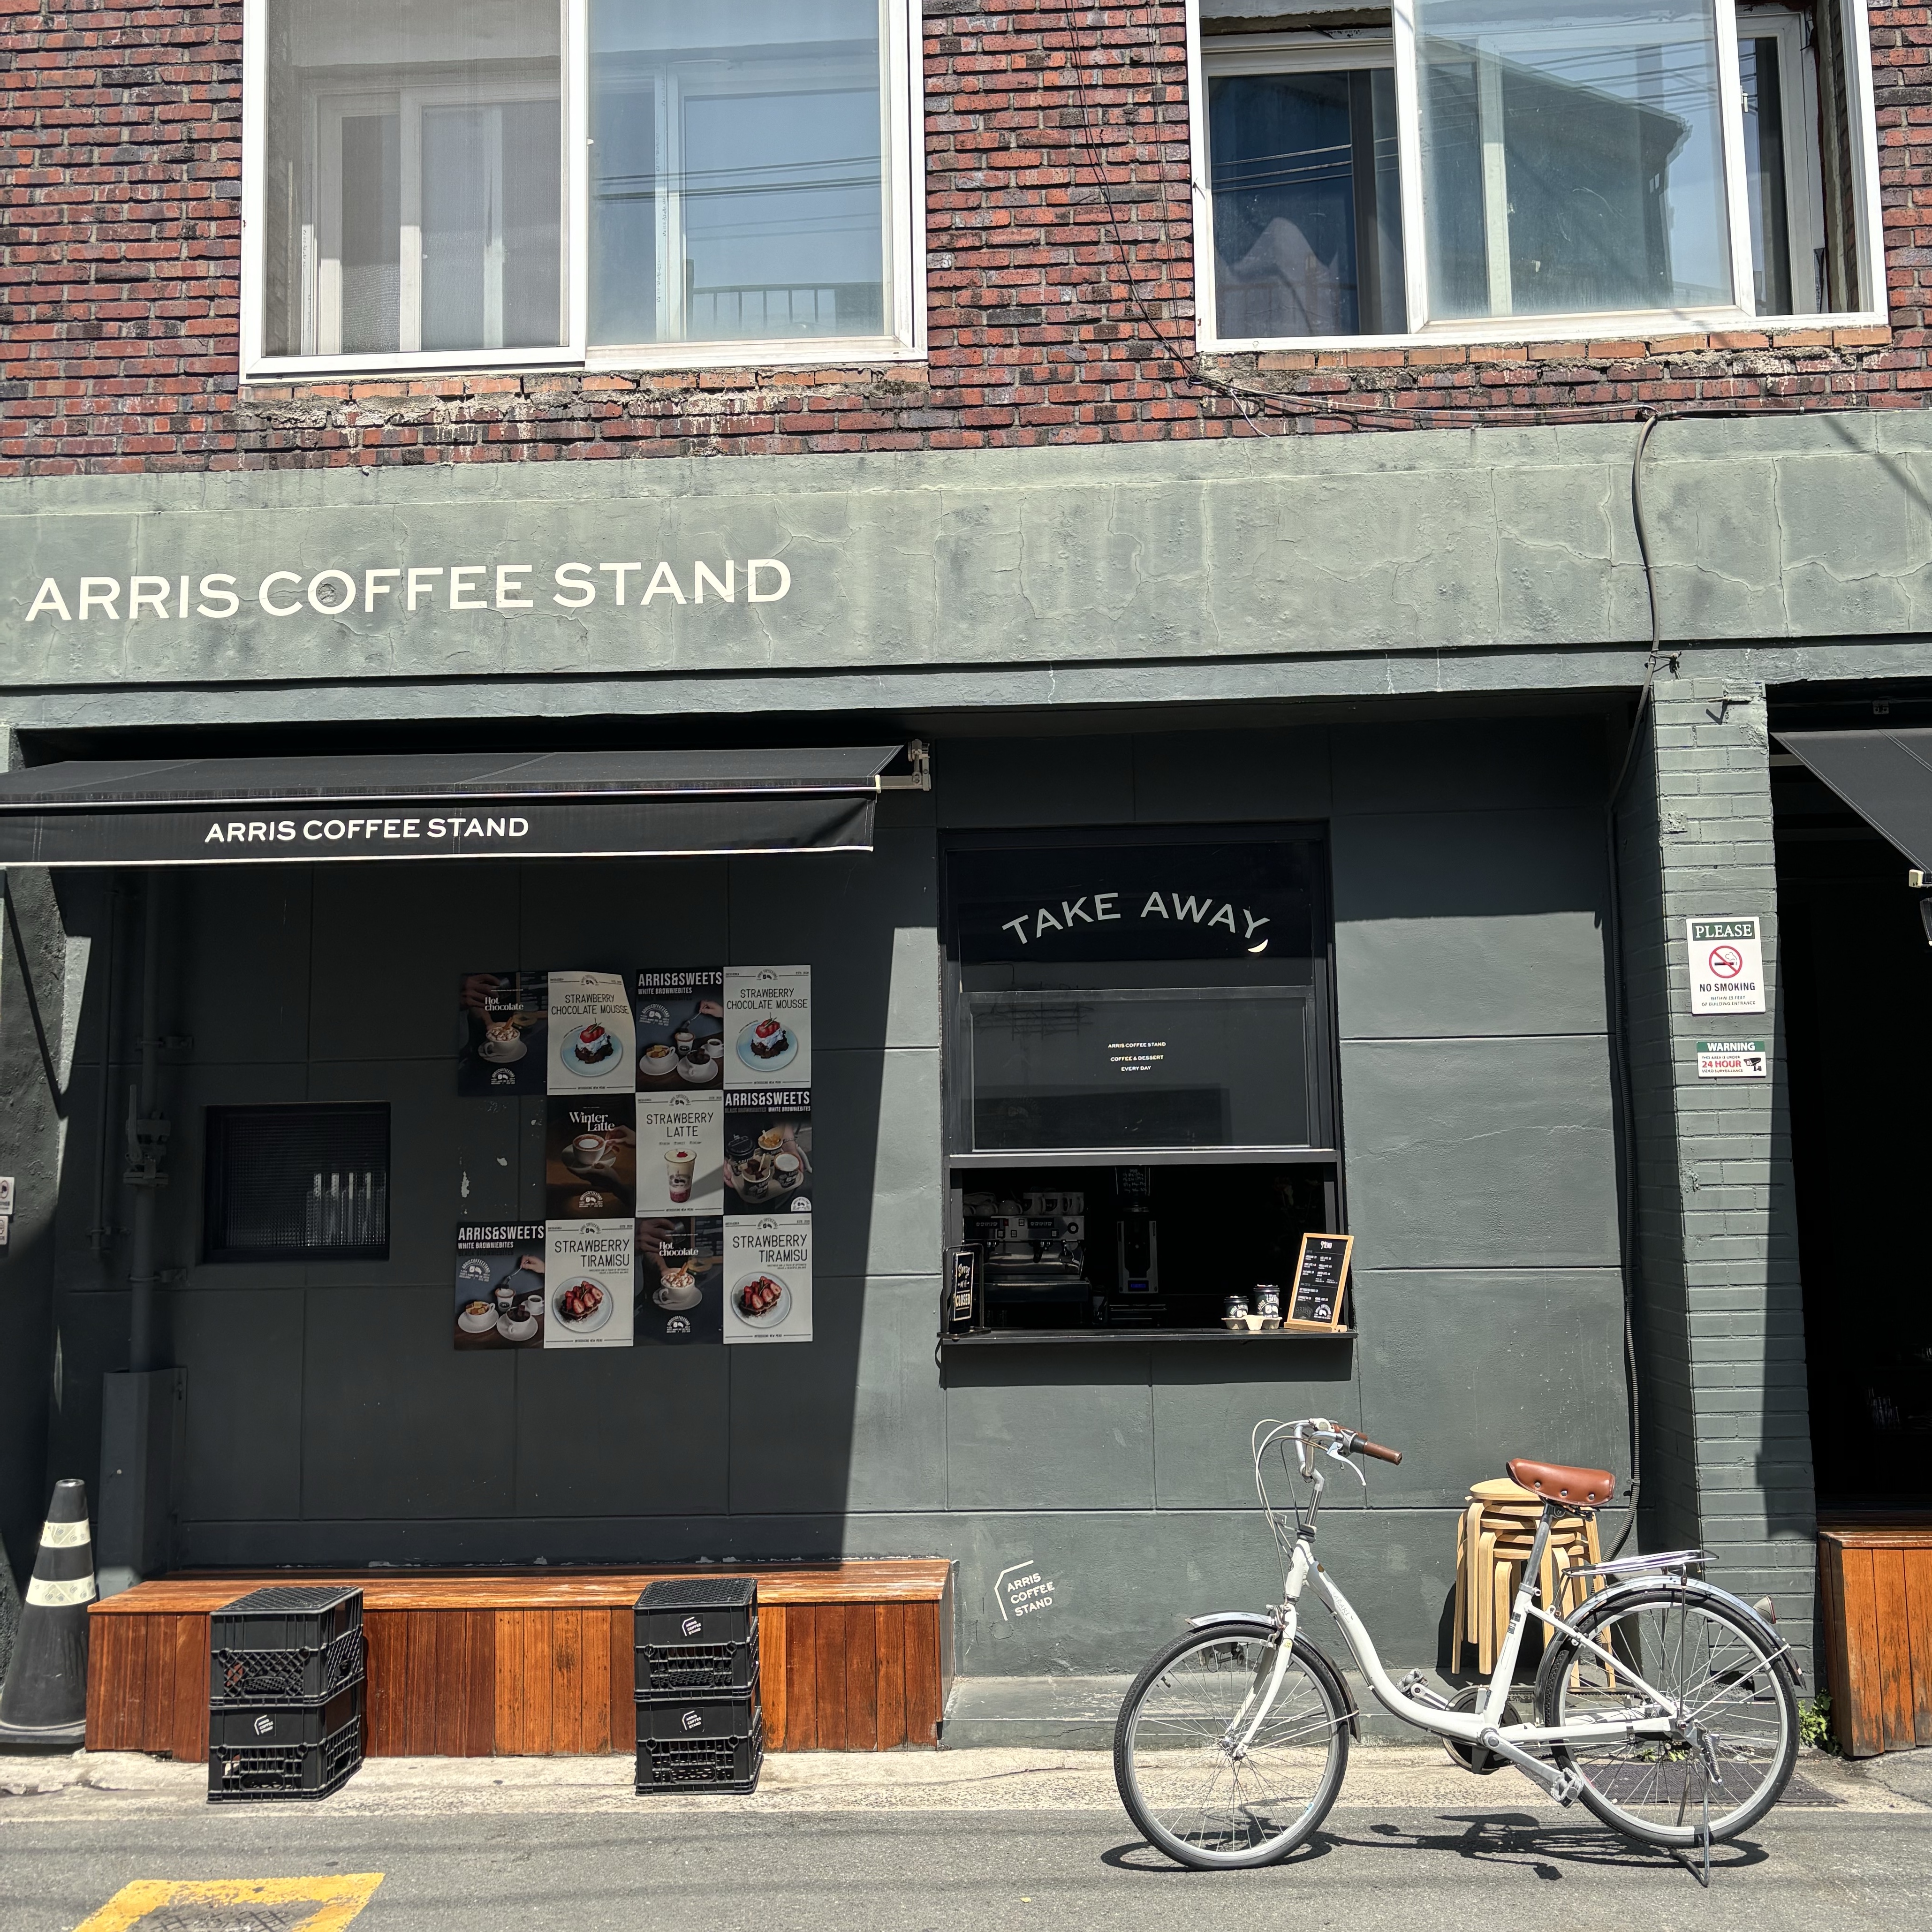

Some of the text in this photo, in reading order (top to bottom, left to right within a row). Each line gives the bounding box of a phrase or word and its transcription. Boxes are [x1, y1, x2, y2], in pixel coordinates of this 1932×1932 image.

[25, 558, 791, 622] ARRIS COFFEE STAND
[204, 817, 529, 844] ARRIS COFFEE STAND
[1002, 891, 1271, 944] TAKE AWAY
[1695, 924, 1752, 938] PLEASE
[638, 972, 722, 986] ARRIS&SWEETS
[740, 988, 795, 998] STRAWBERRY
[1699, 982, 1756, 992] NO SMOKING
[565, 993, 614, 1003] STRAWBERRY
[727, 999, 808, 1009] CHOCOLATE MOUSSE
[551, 1004, 630, 1015] CHOCOLATE MOUSSE
[1707, 1042, 1756, 1052] WARNING
[725, 1091, 810, 1106] ARRIS&SWEETS
[569, 1111, 608, 1123] Winter
[646, 1112, 714, 1125] STRAWBERRY
[587, 1121, 615, 1131] Latte
[667, 1126, 698, 1137] LATTE
[458, 1225, 545, 1241] ARRIS&SWEETS
[555, 1239, 630, 1253] STRAWBERRY
[733, 1234, 807, 1248] STRAWBERRY
[659, 1248, 699, 1257] chocolate
[758, 1249, 808, 1263] TIRAMISU
[580, 1254, 629, 1267] TIRAMISU
[958, 1264, 970, 1279] Sorry
[955, 1293, 970, 1307] CLOSED
[1008, 1573, 1041, 1592] ARRIS
[1011, 1581, 1055, 1604] COFFEE
[1015, 1597, 1053, 1616] STAND
